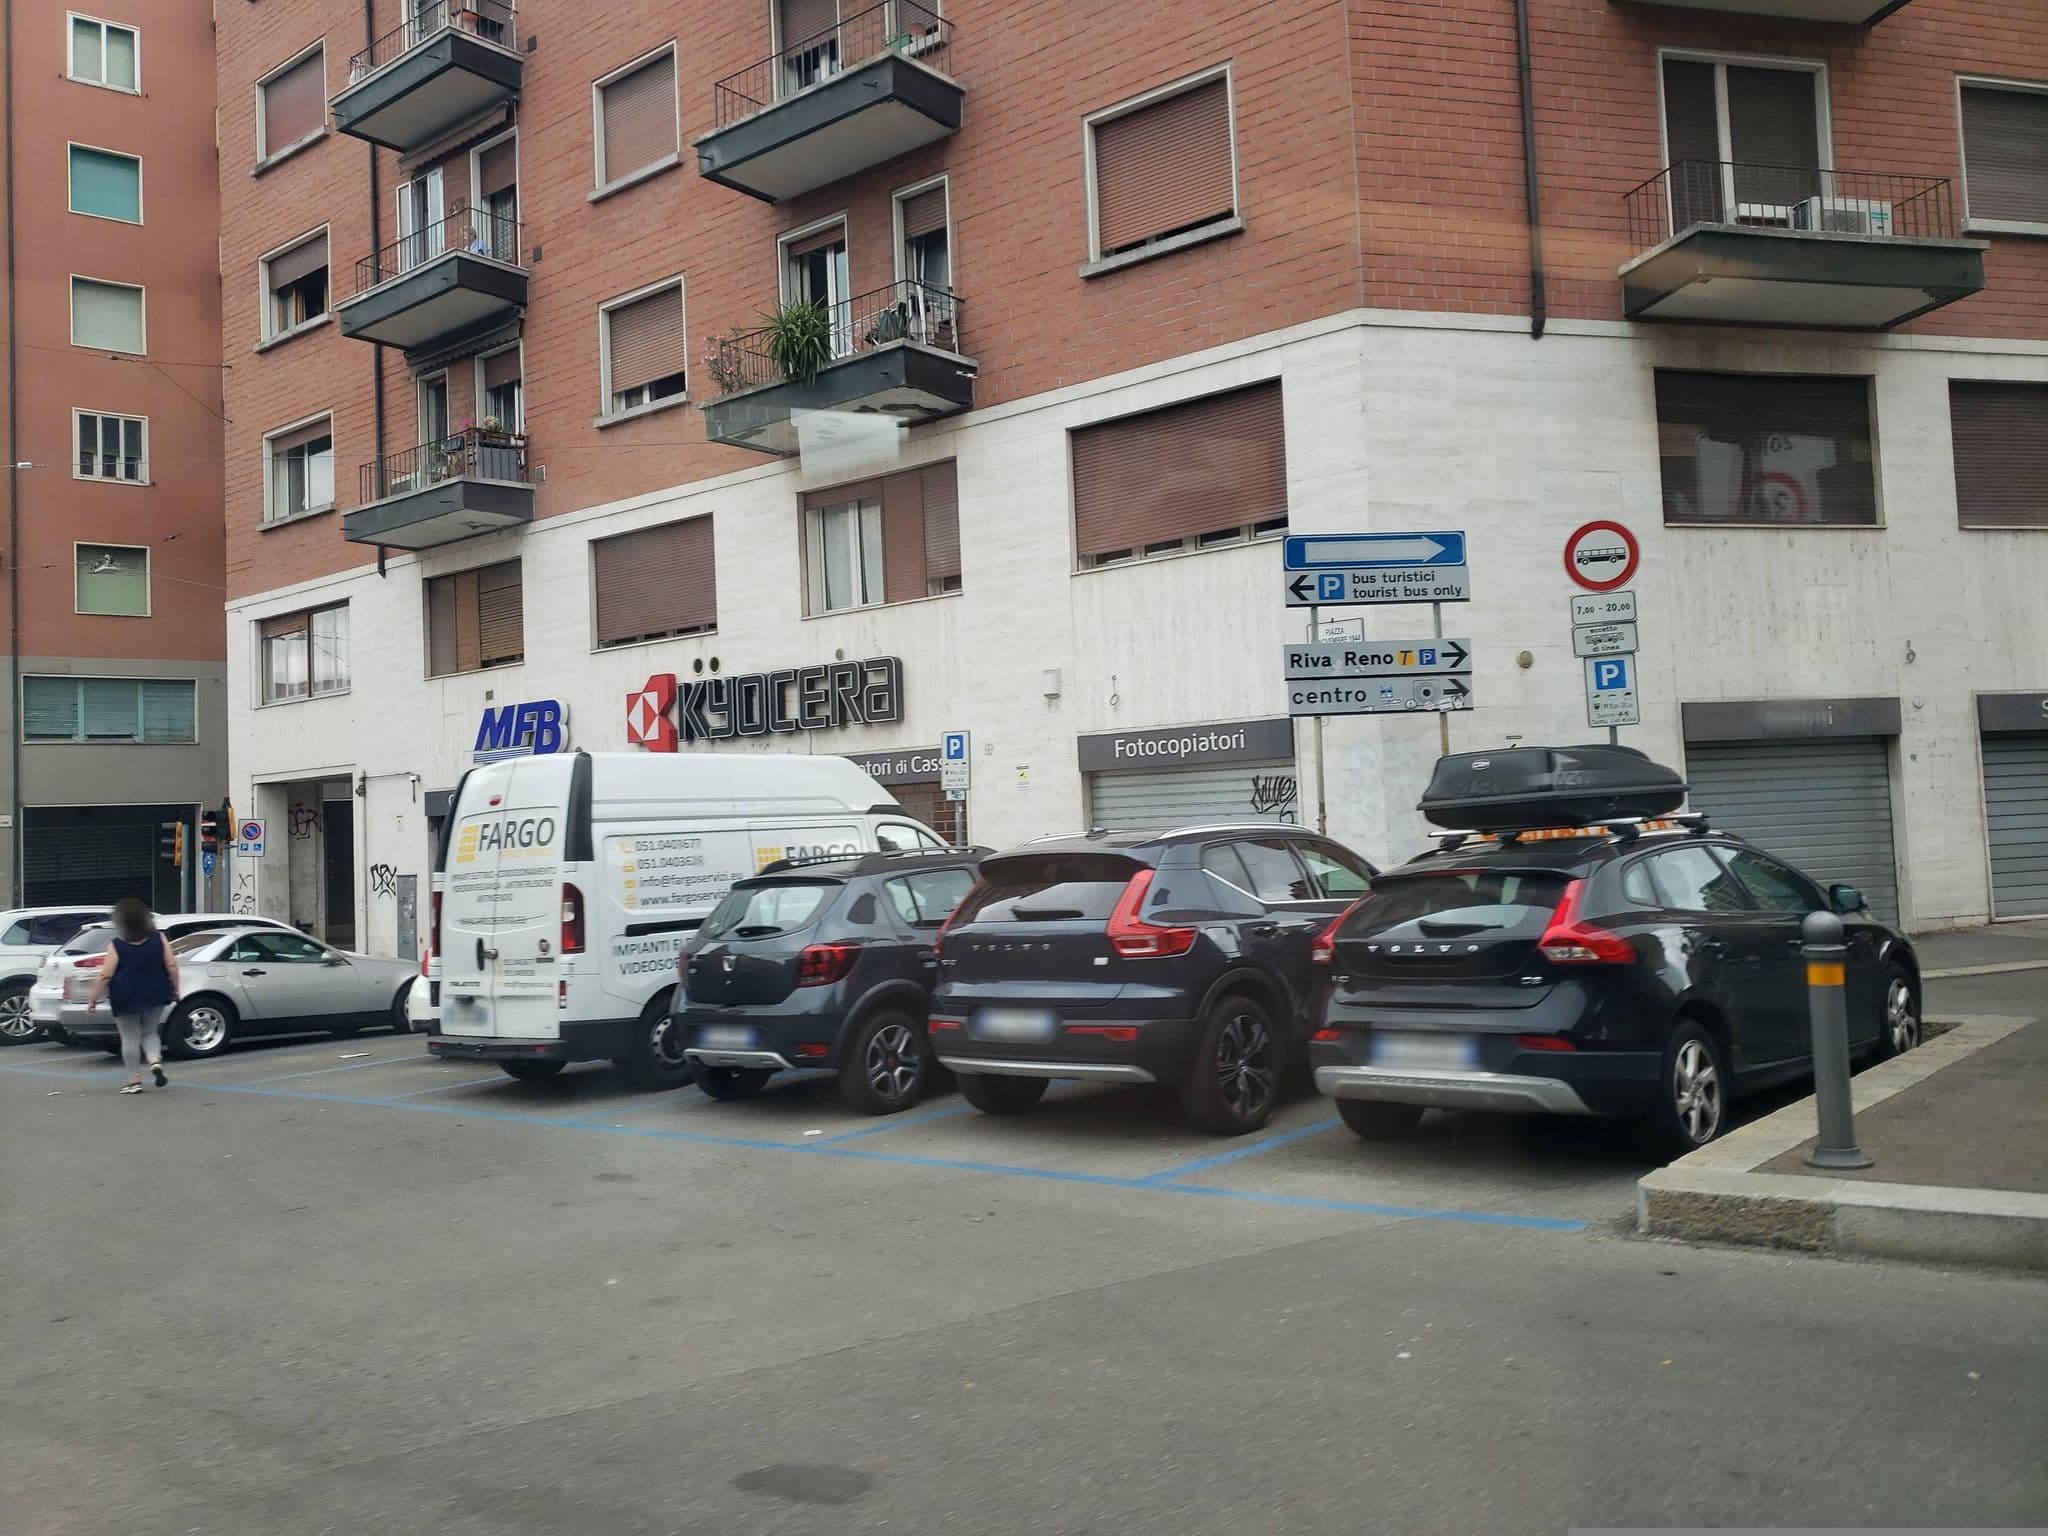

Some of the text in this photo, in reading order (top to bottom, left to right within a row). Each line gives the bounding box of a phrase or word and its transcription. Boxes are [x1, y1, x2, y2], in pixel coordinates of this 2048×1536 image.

[1352, 571, 1435, 584] bus turistici
[1353, 584, 1462, 599] tourist bus only
[1290, 653, 1332, 668] Riva
[1345, 651, 1393, 666] Reno
[1292, 687, 1367, 705] centro
[474, 698, 568, 755] MFB
[1114, 729, 1246, 758] Fotocopiatori
[896, 759, 907, 774] di
[478, 817, 554, 852] FARGO
[613, 942, 671, 956] IMPIANTI
[1367, 944, 1479, 953] VOLVO
